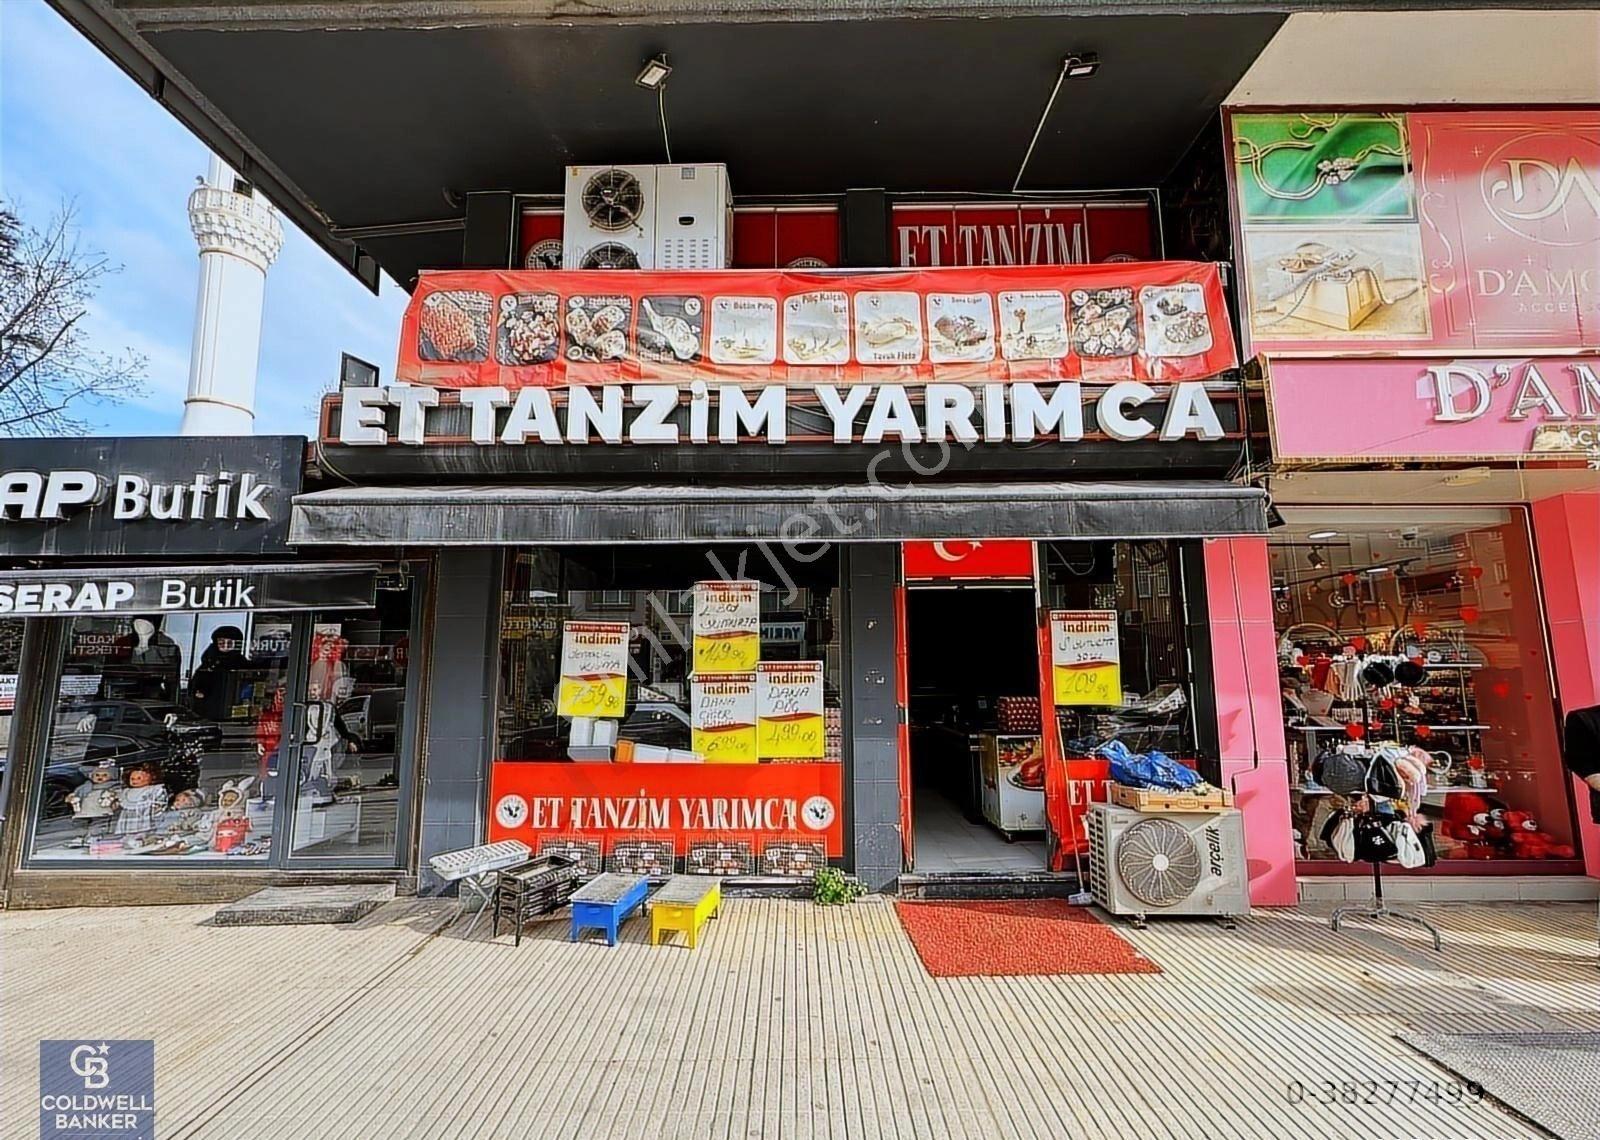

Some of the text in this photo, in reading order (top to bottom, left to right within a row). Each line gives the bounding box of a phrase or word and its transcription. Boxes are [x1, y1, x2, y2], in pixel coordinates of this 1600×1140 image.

[897, 225, 948, 268] ET
[339, 386, 440, 446] ET
[459, 380, 788, 445] TANZİM
[113, 471, 272, 521] Butik
[160, 578, 256, 609] Butik
[705, 591, 753, 603] indirim
[1063, 621, 1111, 633] indirim
[574, 633, 622, 646] indirim
[702, 683, 750, 695] indirim
[768, 672, 815, 685] indirim
[767, 686, 810, 700] DANA
[532, 788, 798, 831] ET TANZİM YARIMCA
[1205, 825, 1223, 877] arçelik
